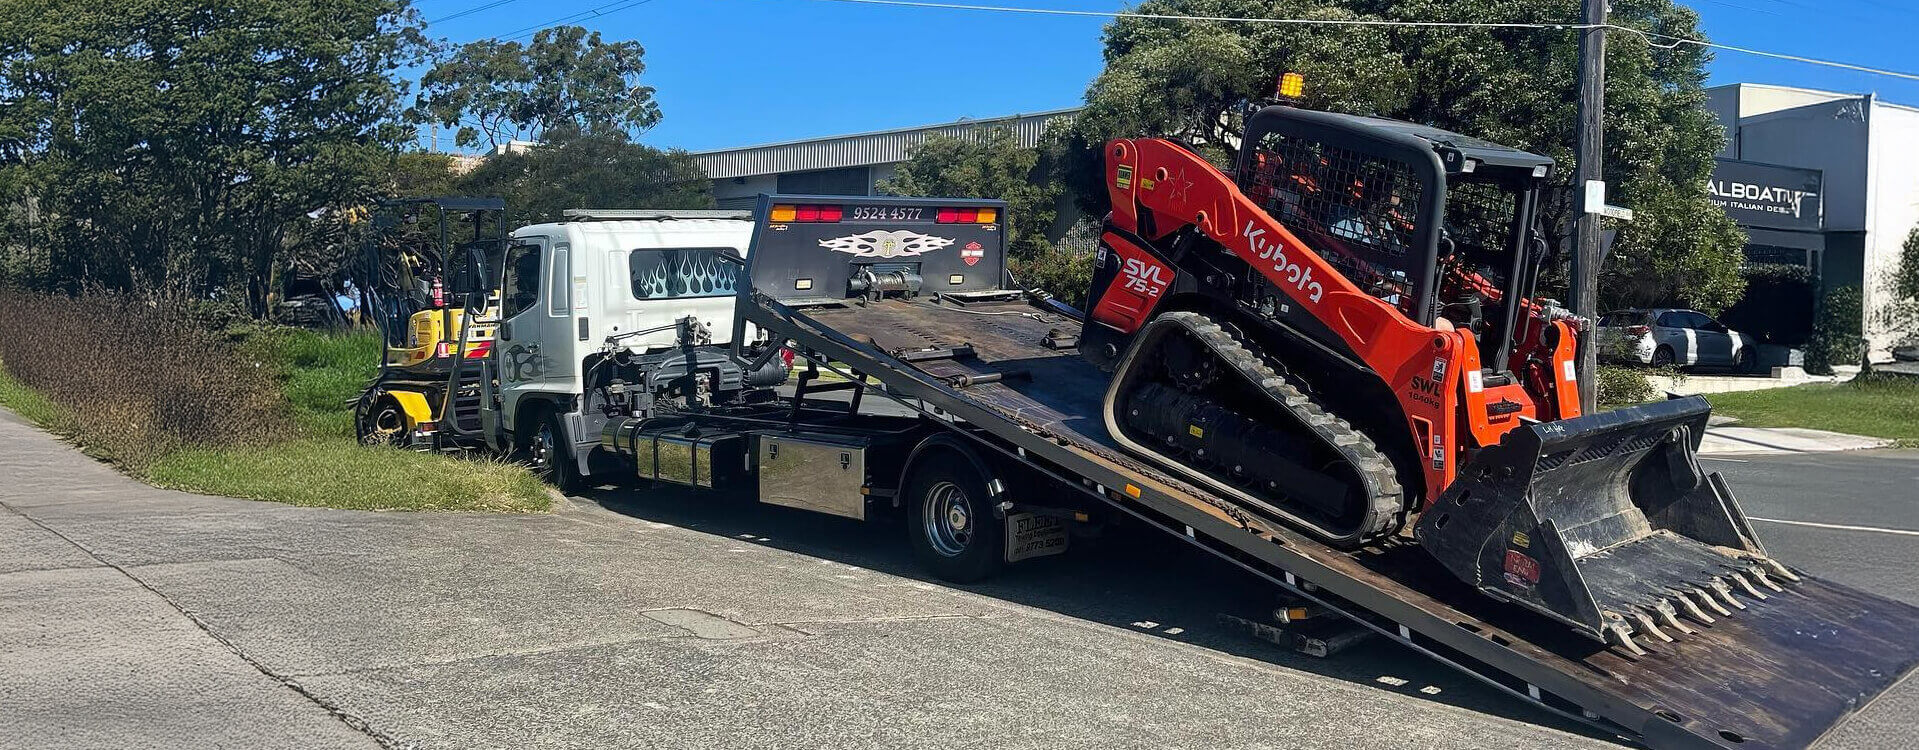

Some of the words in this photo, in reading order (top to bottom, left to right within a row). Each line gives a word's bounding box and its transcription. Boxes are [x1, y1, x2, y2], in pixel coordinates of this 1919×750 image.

[853, 207, 887, 220] 9524
[890, 207, 923, 220] 4577
[1730, 200, 1764, 211] ITALIAN
[1123, 258, 1167, 286] SVL
[1243, 220, 1323, 304] Kubota
[1125, 275, 1159, 297] 75-2
[1411, 376, 1440, 398] SWL
